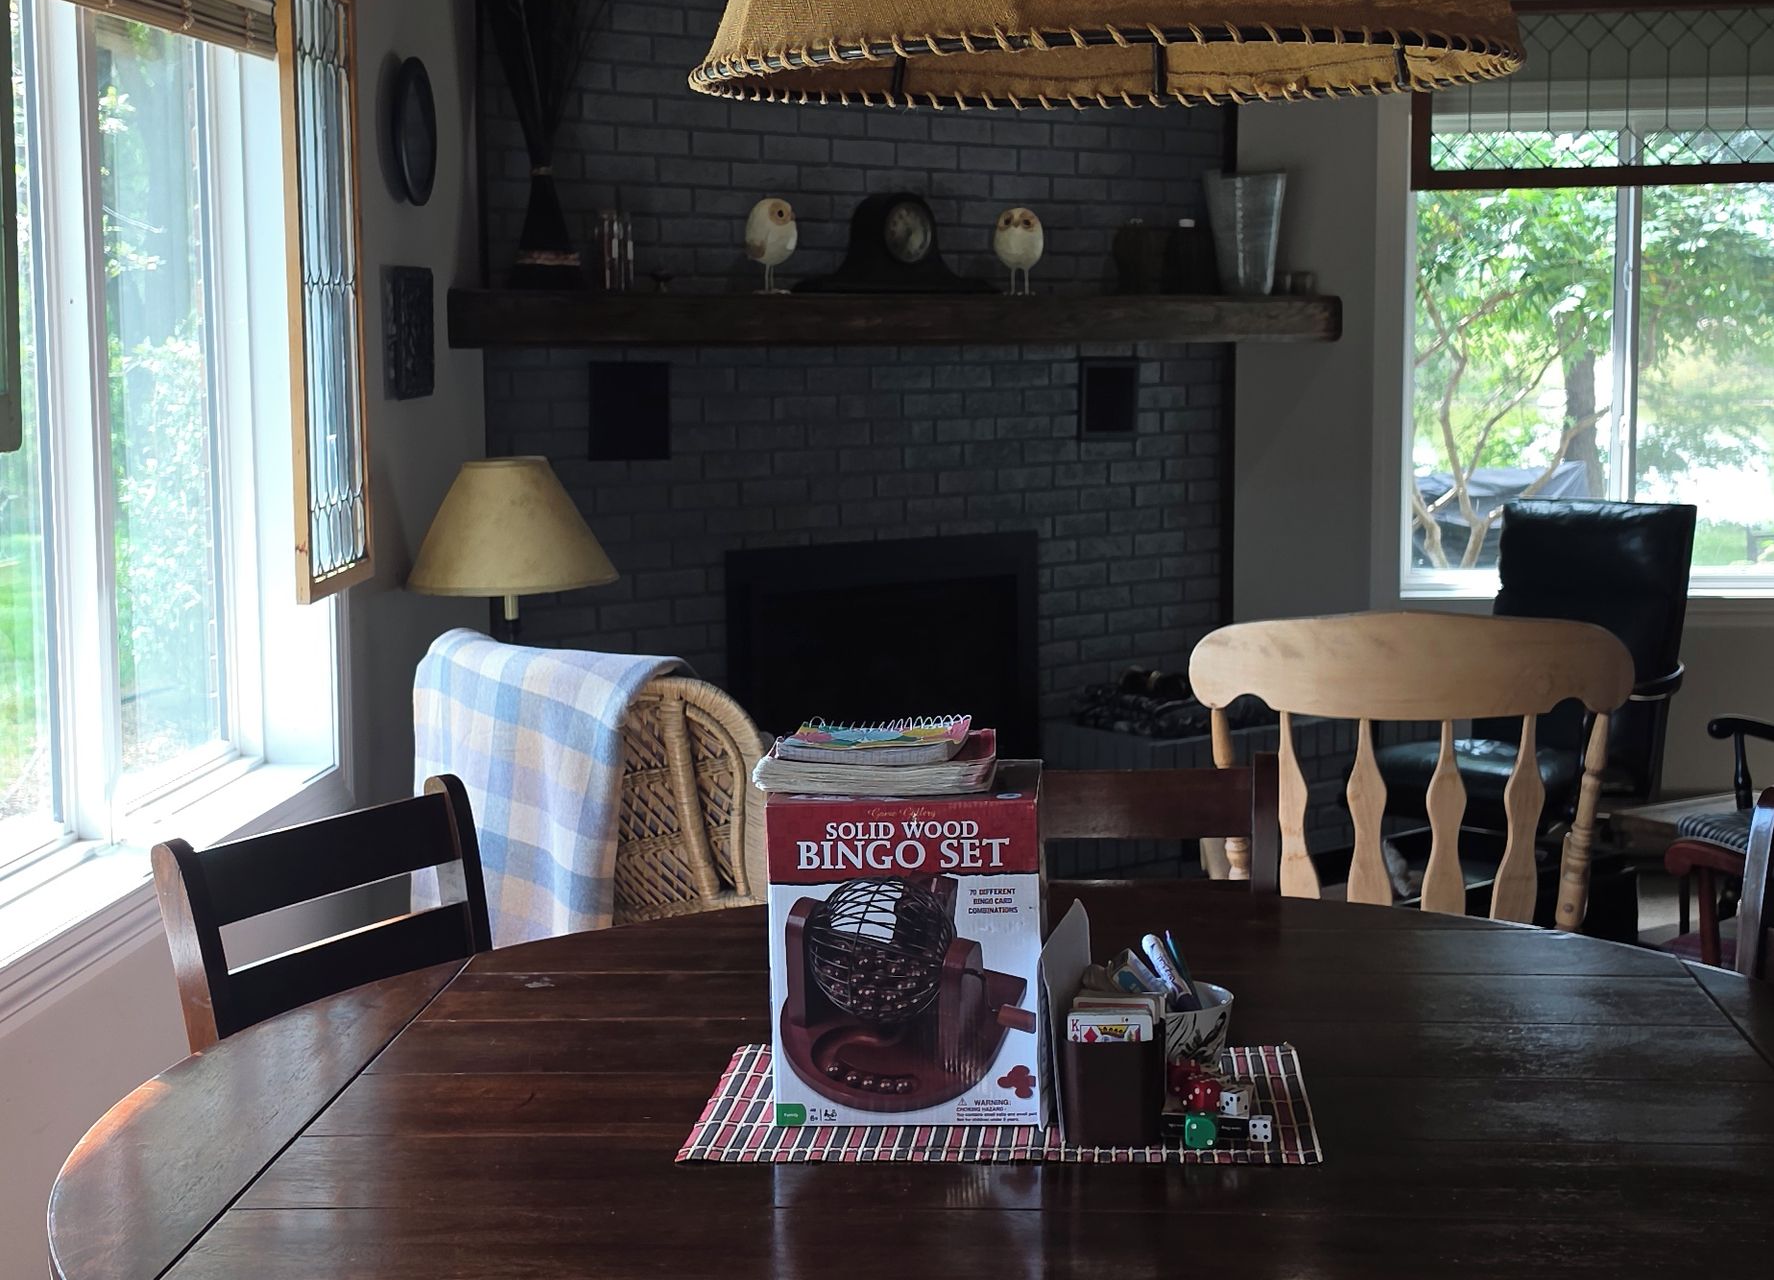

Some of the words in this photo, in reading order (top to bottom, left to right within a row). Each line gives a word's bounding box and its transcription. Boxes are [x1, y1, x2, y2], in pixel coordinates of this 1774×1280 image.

[826, 822, 895, 840] SOLID
[901, 821, 979, 839] WOOD
[797, 839, 926, 870] BINGO
[940, 838, 1010, 868] SET
[1071, 1019, 1079, 1031] K
